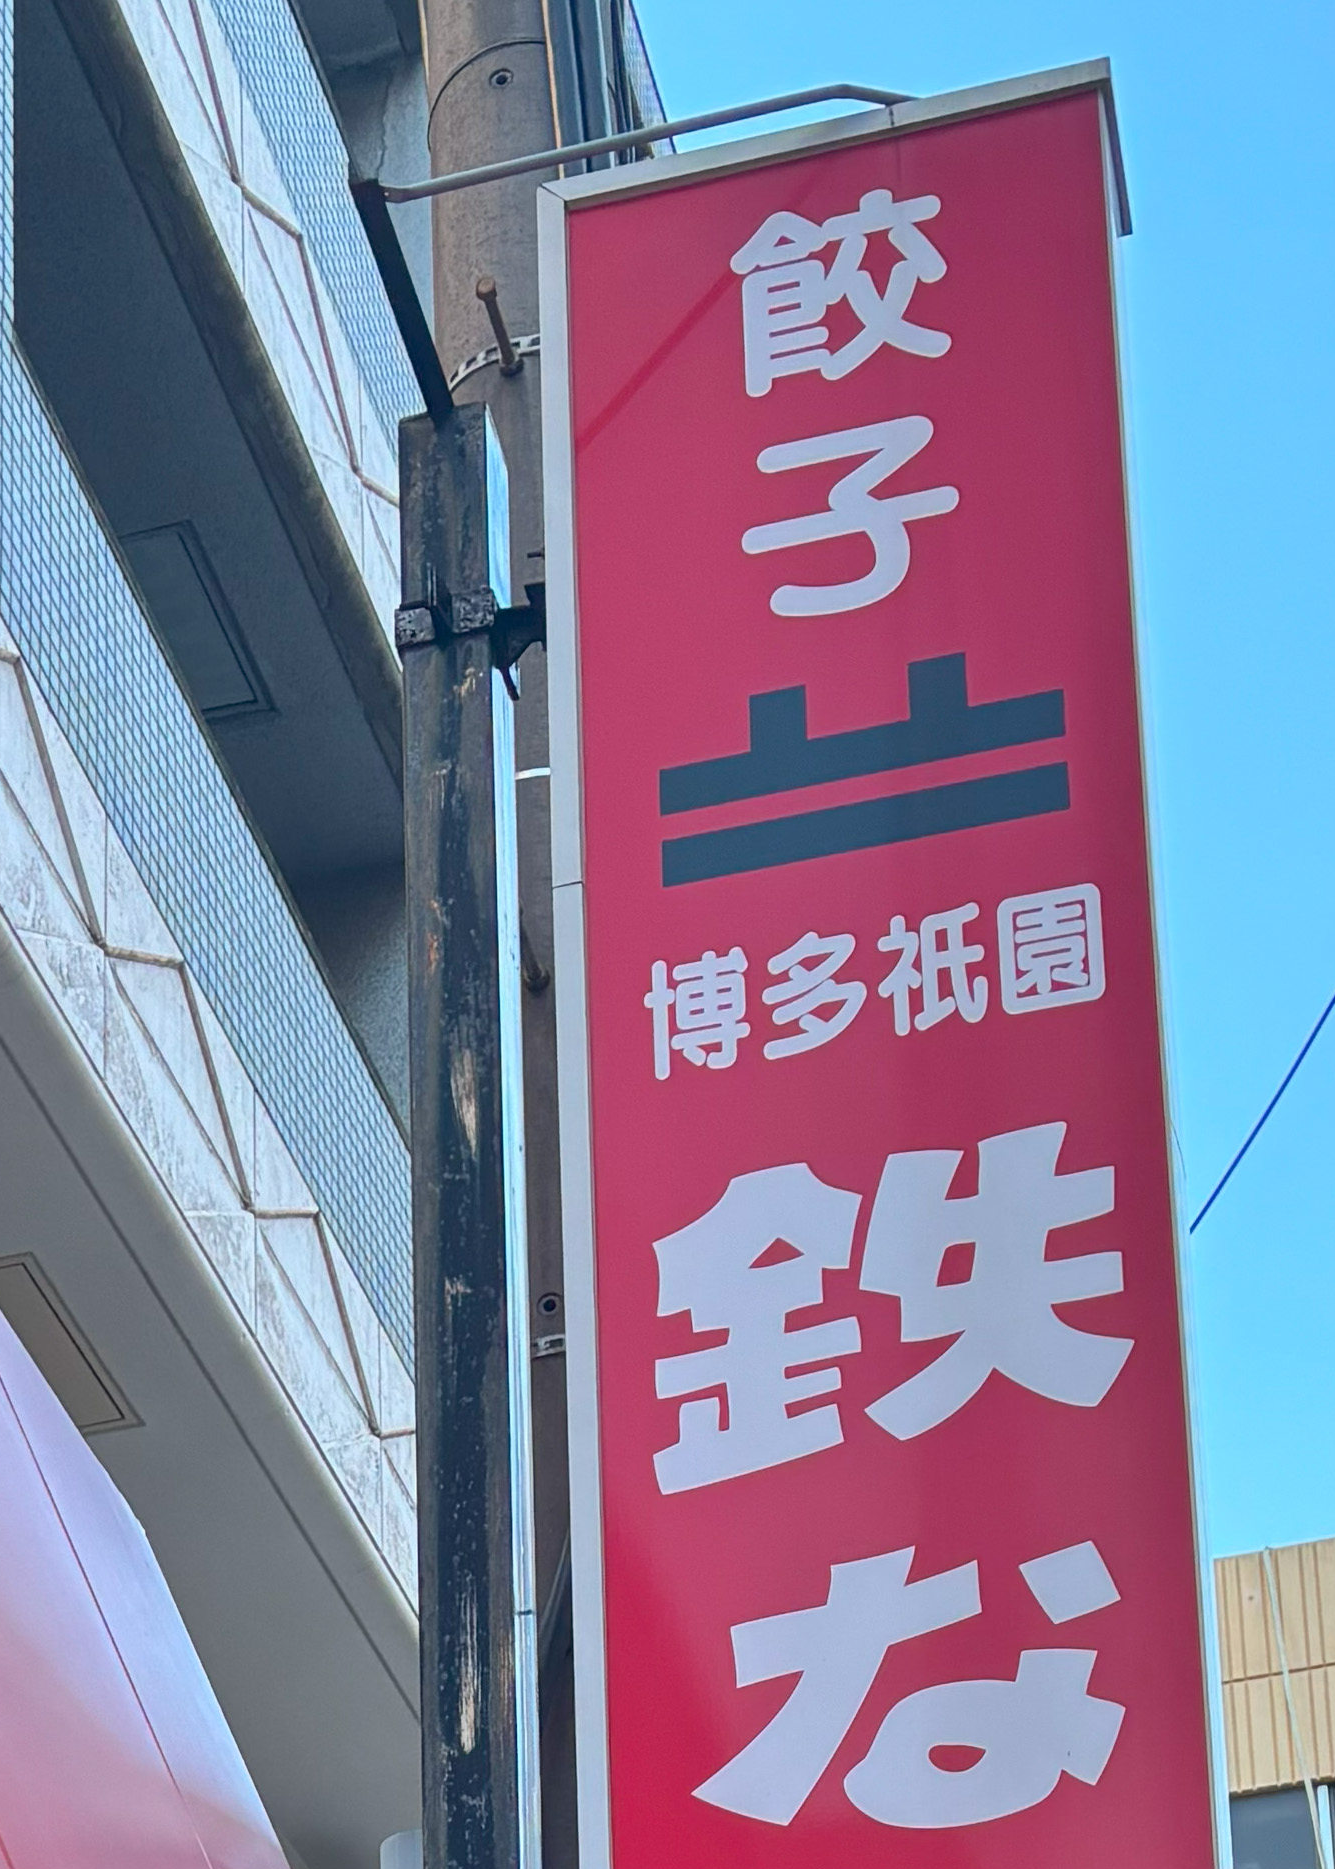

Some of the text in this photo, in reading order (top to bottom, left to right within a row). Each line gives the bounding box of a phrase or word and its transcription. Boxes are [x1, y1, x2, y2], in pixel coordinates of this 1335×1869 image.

[730, 189, 959, 617] 餃子
[644, 883, 1106, 1081] 博多祇園
